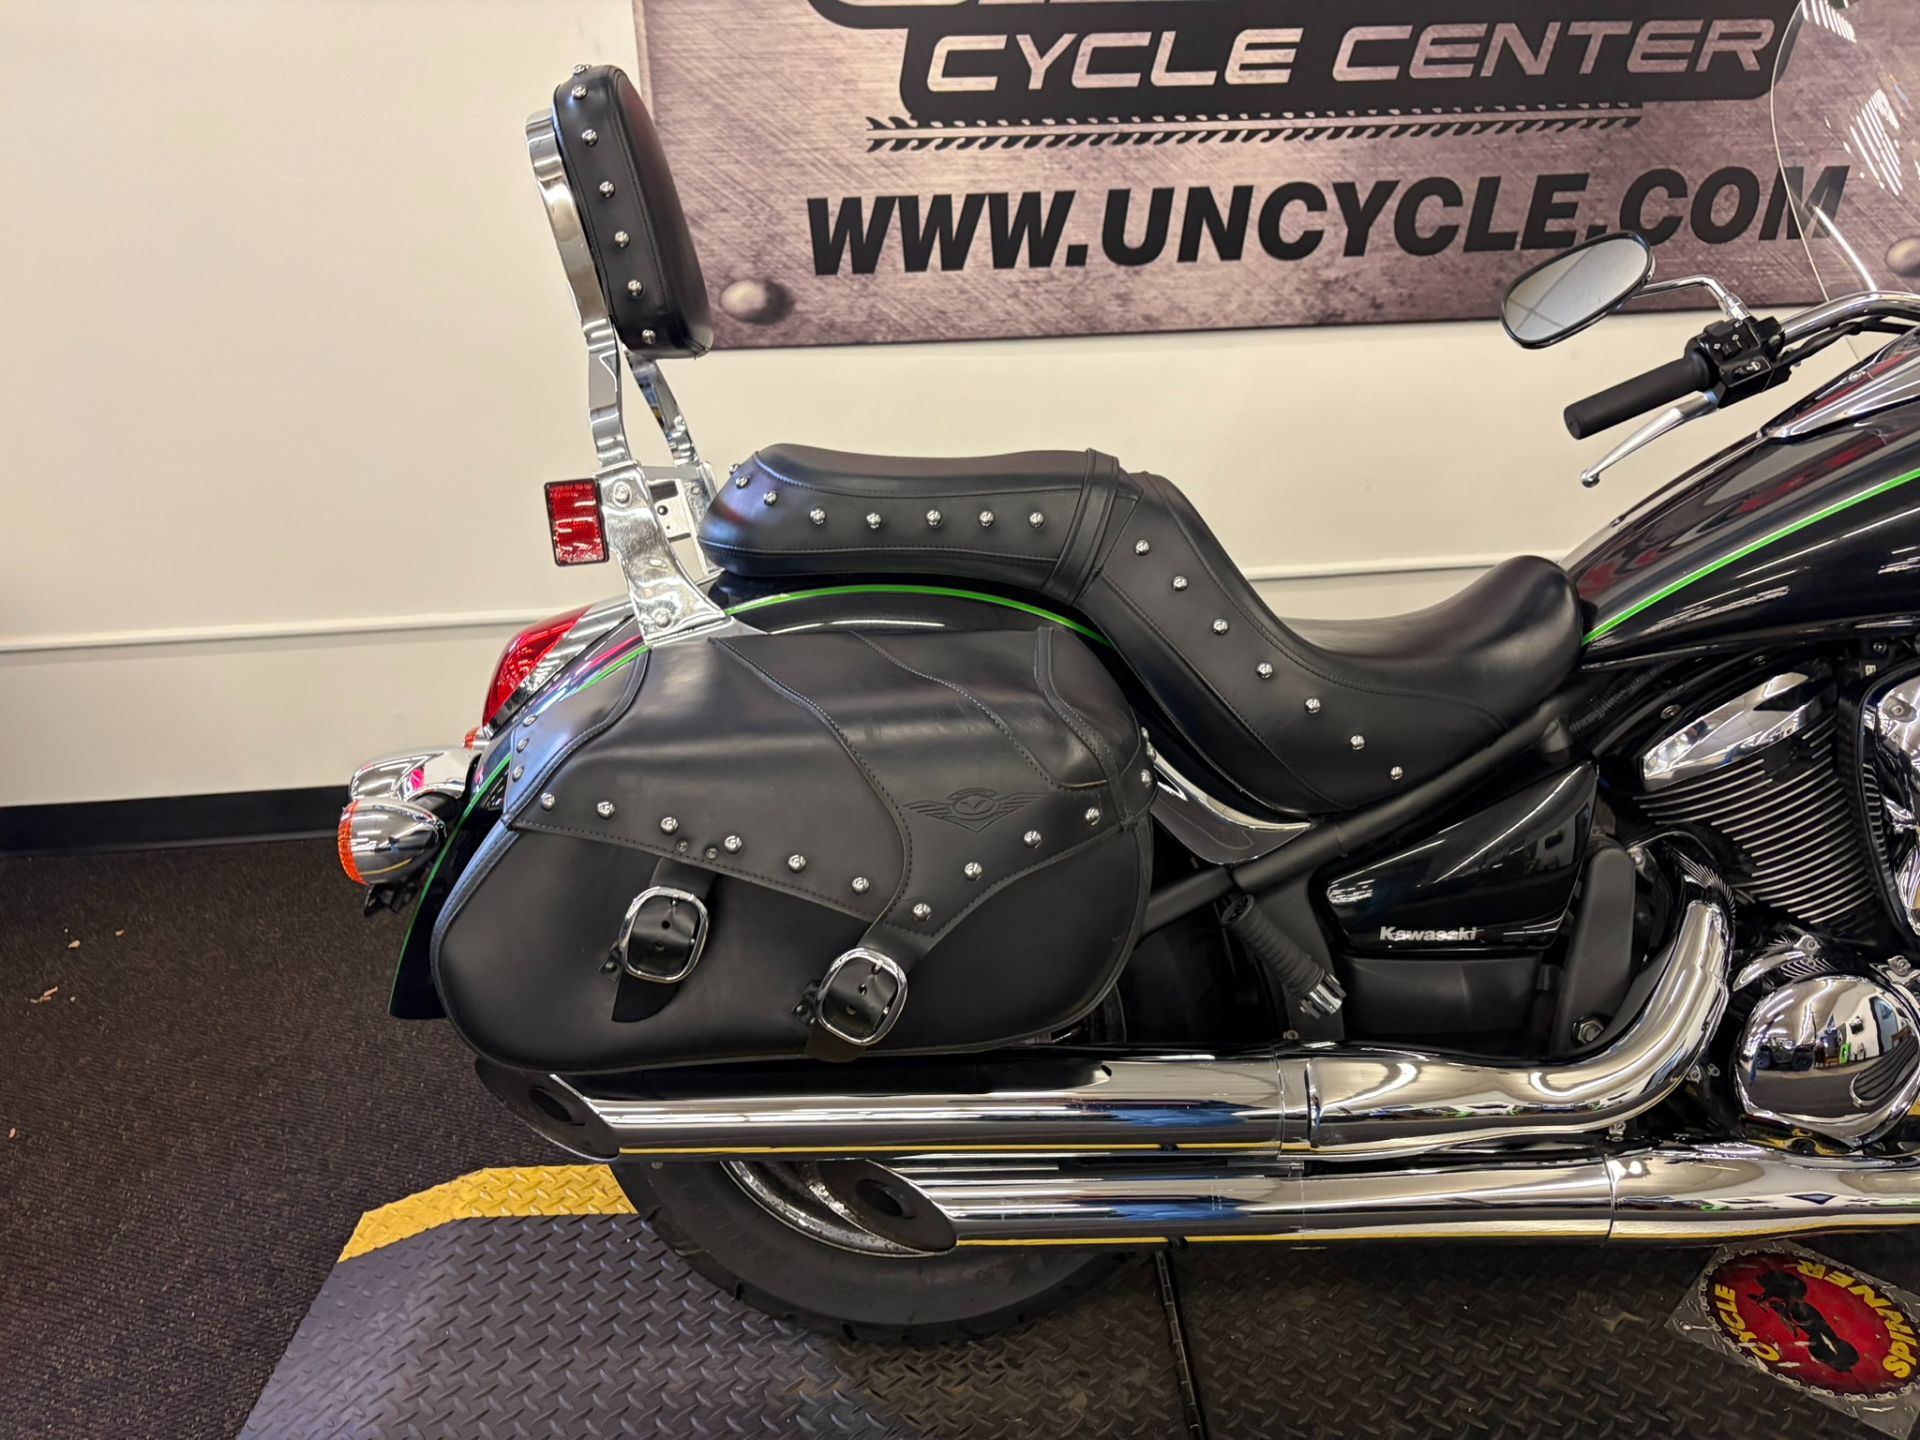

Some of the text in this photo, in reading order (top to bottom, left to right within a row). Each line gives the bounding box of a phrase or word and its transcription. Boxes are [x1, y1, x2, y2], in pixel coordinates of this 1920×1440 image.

[926, 18, 1775, 93] CYCLE CENTER
[807, 165, 1850, 276] WWW.UNCYCLE.COM
[1380, 926, 1477, 941] Kawasaki
[1715, 1283, 1781, 1362] CYCLE
[1797, 1259, 1918, 1378] SPINNER
